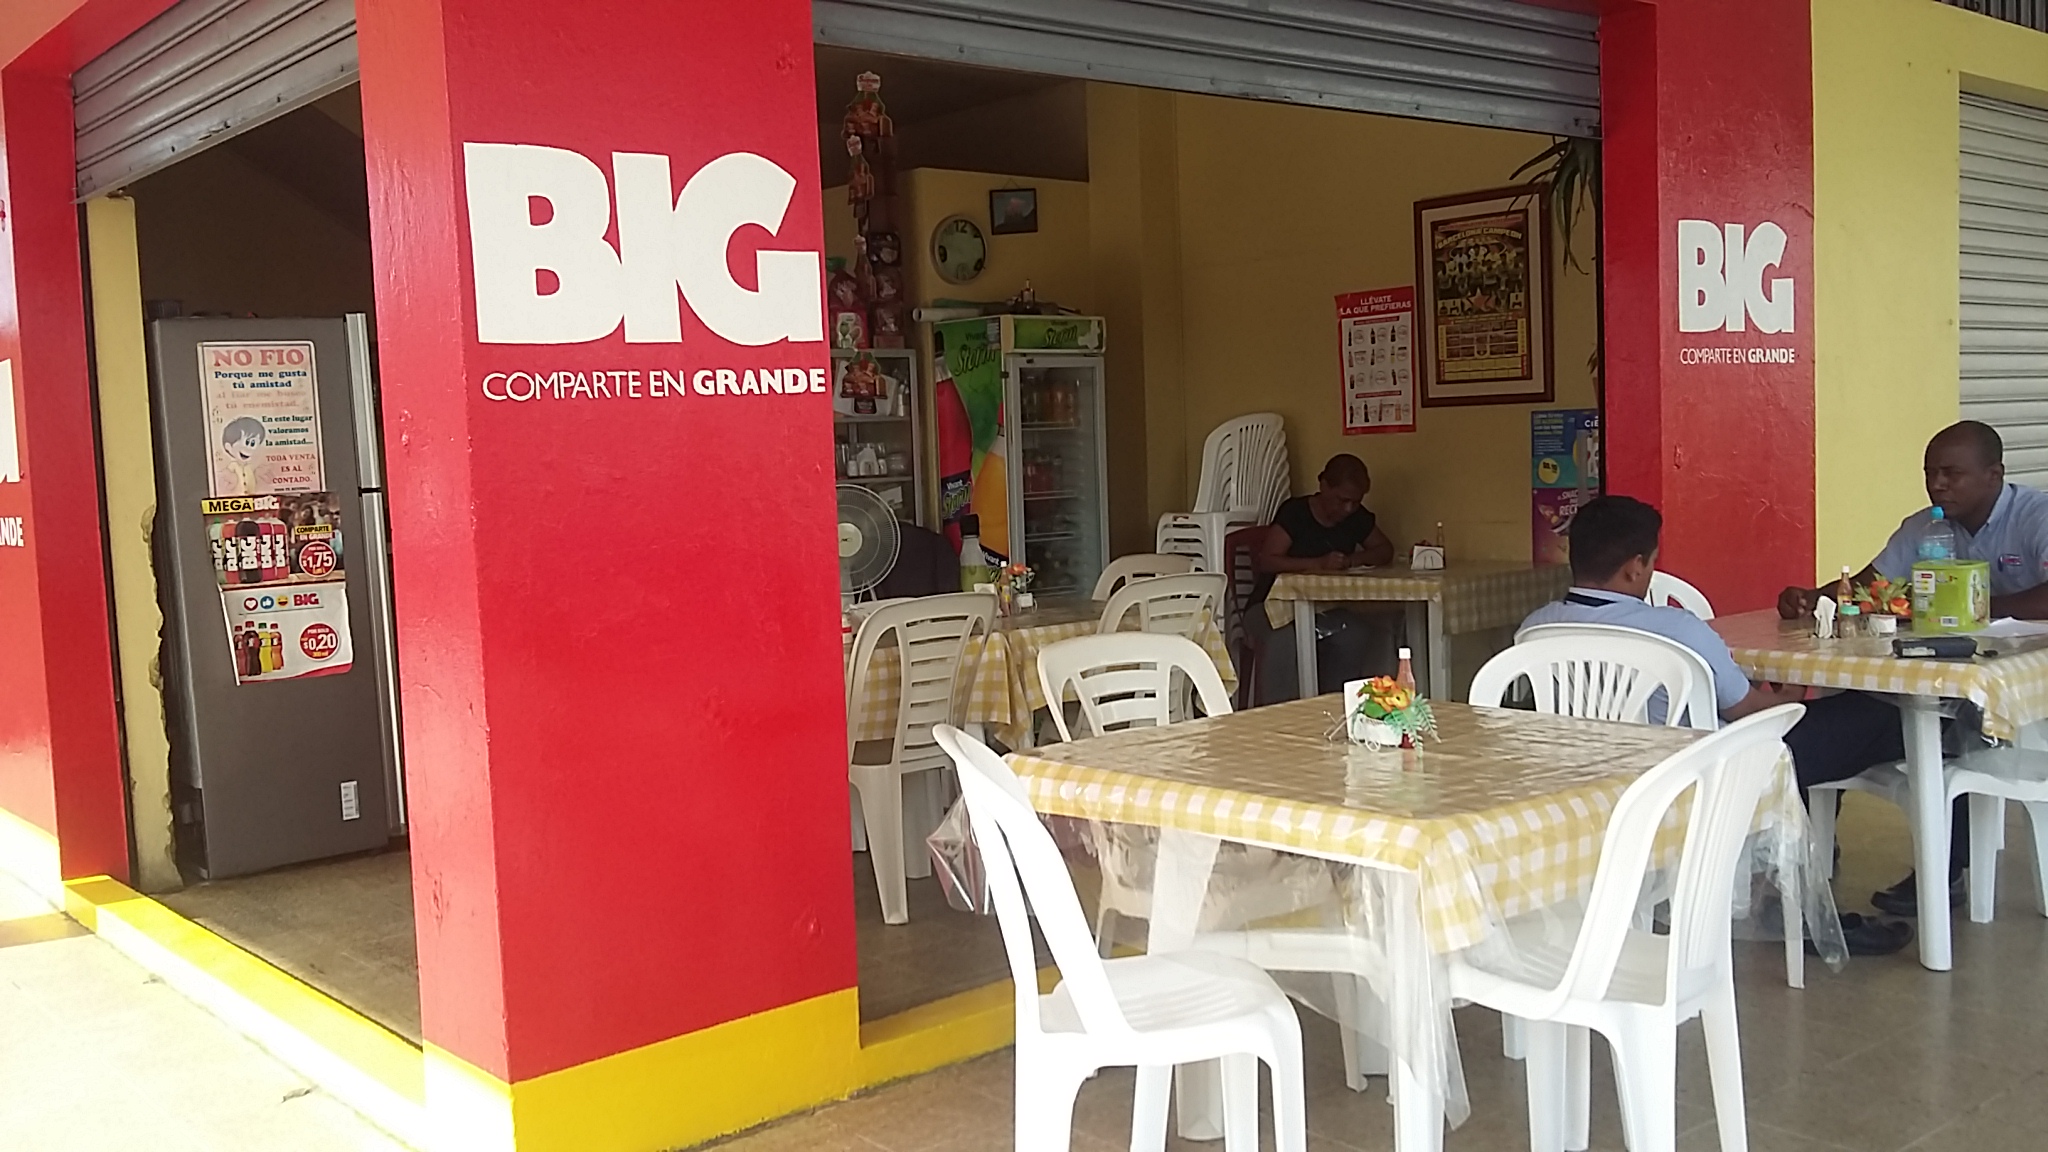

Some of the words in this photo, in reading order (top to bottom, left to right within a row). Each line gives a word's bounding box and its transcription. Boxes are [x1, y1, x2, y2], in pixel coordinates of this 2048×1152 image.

[463, 141, 824, 346] BIG
[1678, 220, 1794, 334] BIG
[1340, 307, 1352, 315] LA
[1354, 304, 1369, 314] QUE
[1370, 300, 1412, 312] PREFIERAS
[214, 350, 252, 366] NO
[260, 349, 304, 366] FIO
[1680, 348, 1732, 364] COMPARTE
[1734, 348, 1746, 364] EN
[1748, 348, 1795, 364] GRANDE
[214, 371, 253, 379] Porque
[278, 370, 307, 378] gusta
[482, 371, 641, 402] COMPARTE
[650, 369, 686, 397] EN
[692, 368, 826, 396] GRANDE
[292, 414, 313, 423] lugar
[254, 496, 280, 511] BIG
[296, 525, 330, 533] COMPARTE
[240, 536, 258, 570] BIG
[294, 593, 319, 606] BIG
